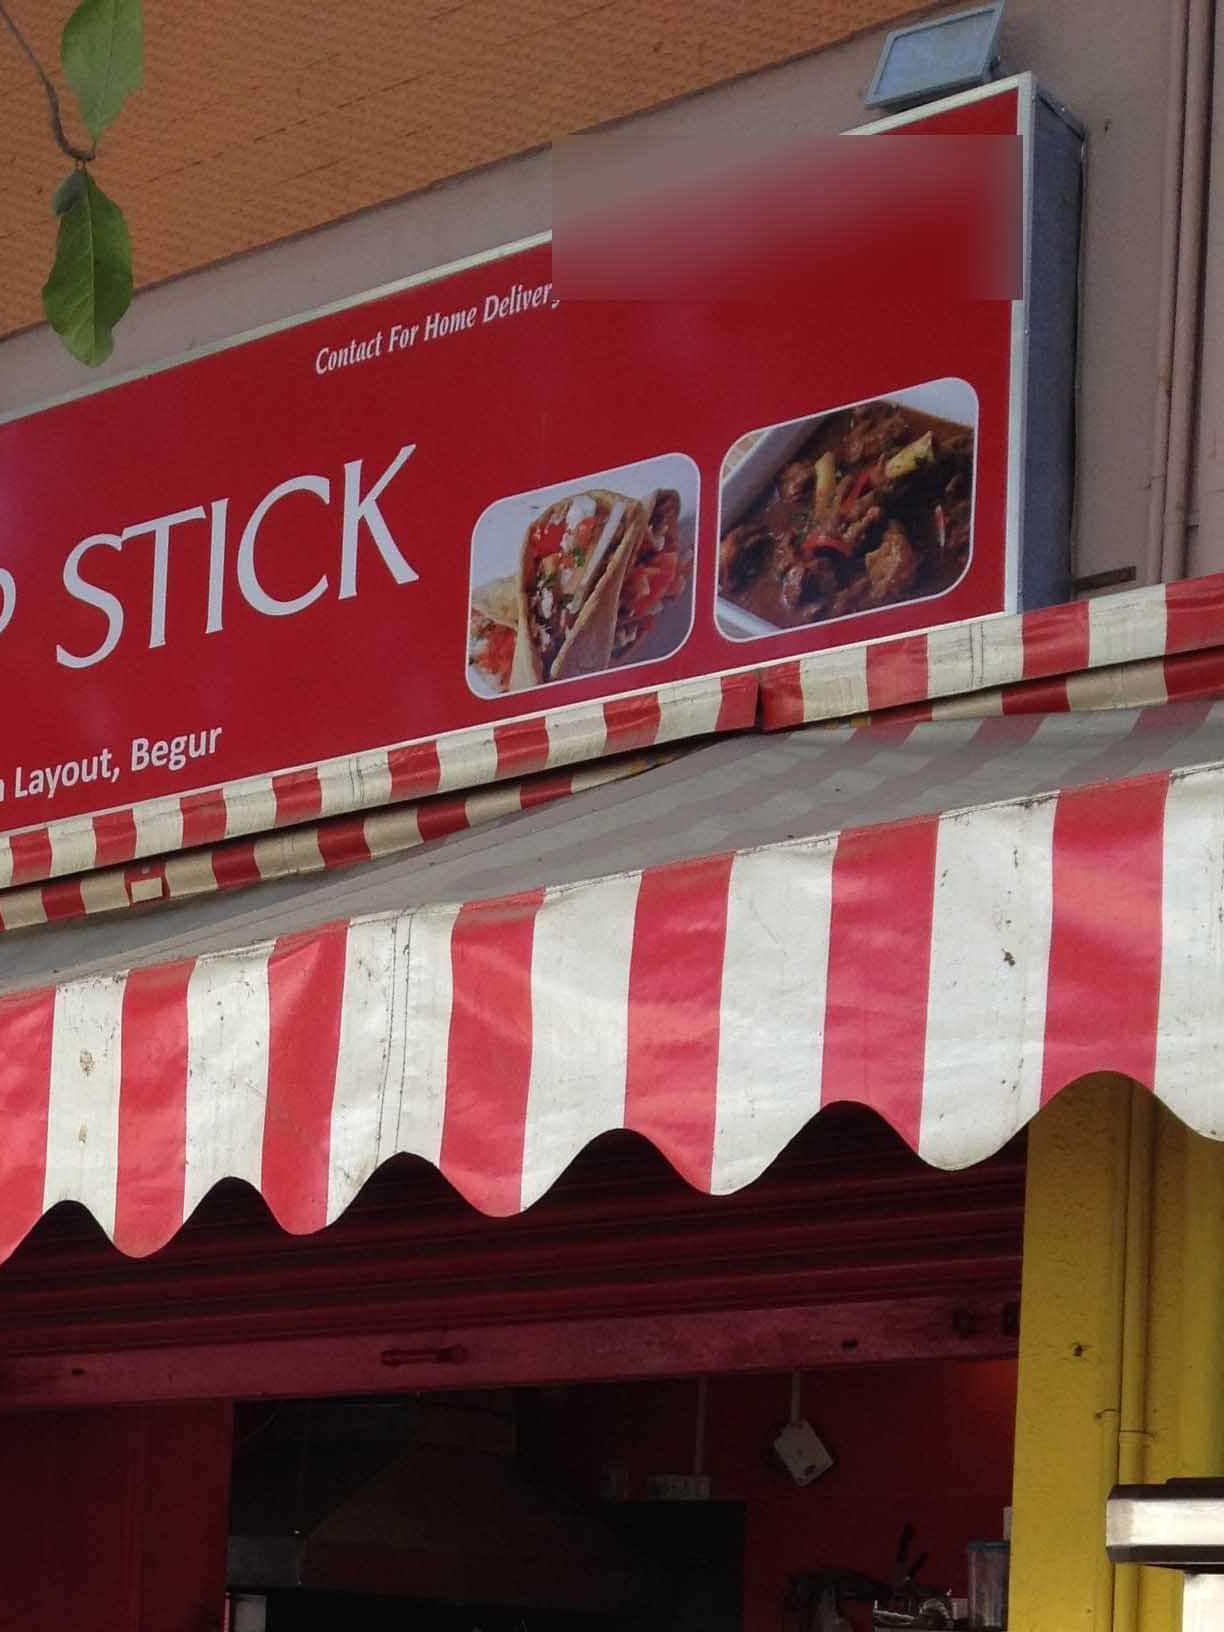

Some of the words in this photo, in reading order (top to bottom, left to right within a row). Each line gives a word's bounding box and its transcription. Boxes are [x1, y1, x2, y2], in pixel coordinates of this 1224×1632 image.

[315, 331, 383, 375] Contact
[388, 325, 420, 353] For
[423, 307, 478, 341] Home
[482, 283, 561, 323] Deliver
[55, 444, 419, 669] STICK
[14, 748, 121, 799] Layout,
[130, 727, 224, 772] Begur
